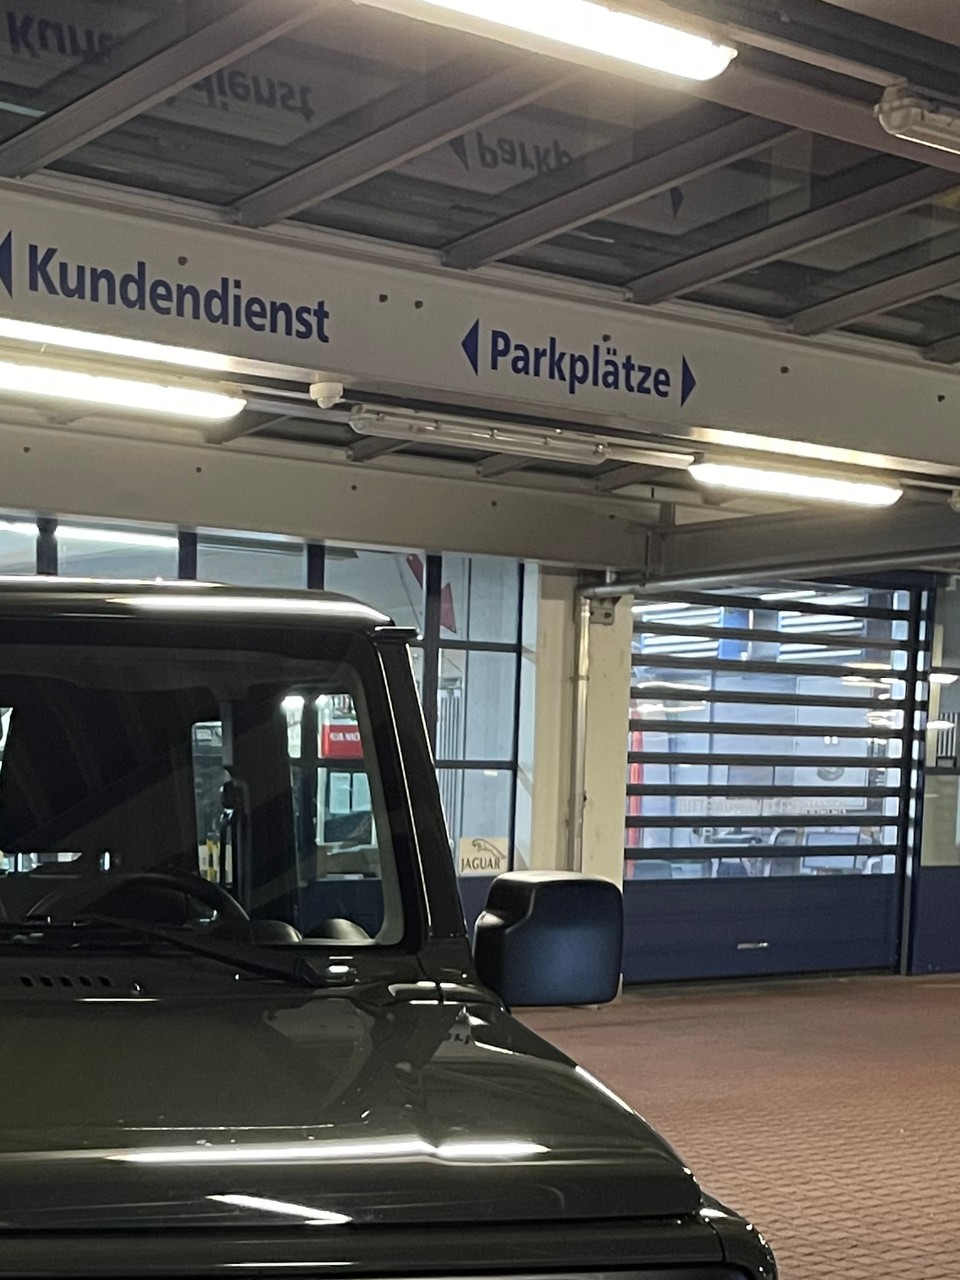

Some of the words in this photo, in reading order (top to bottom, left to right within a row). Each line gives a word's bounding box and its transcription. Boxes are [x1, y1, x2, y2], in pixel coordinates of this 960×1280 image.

[27, 243, 330, 343] Kundendienst
[491, 330, 671, 398] Parkplätze
[461, 857, 501, 873] JAGUAR
